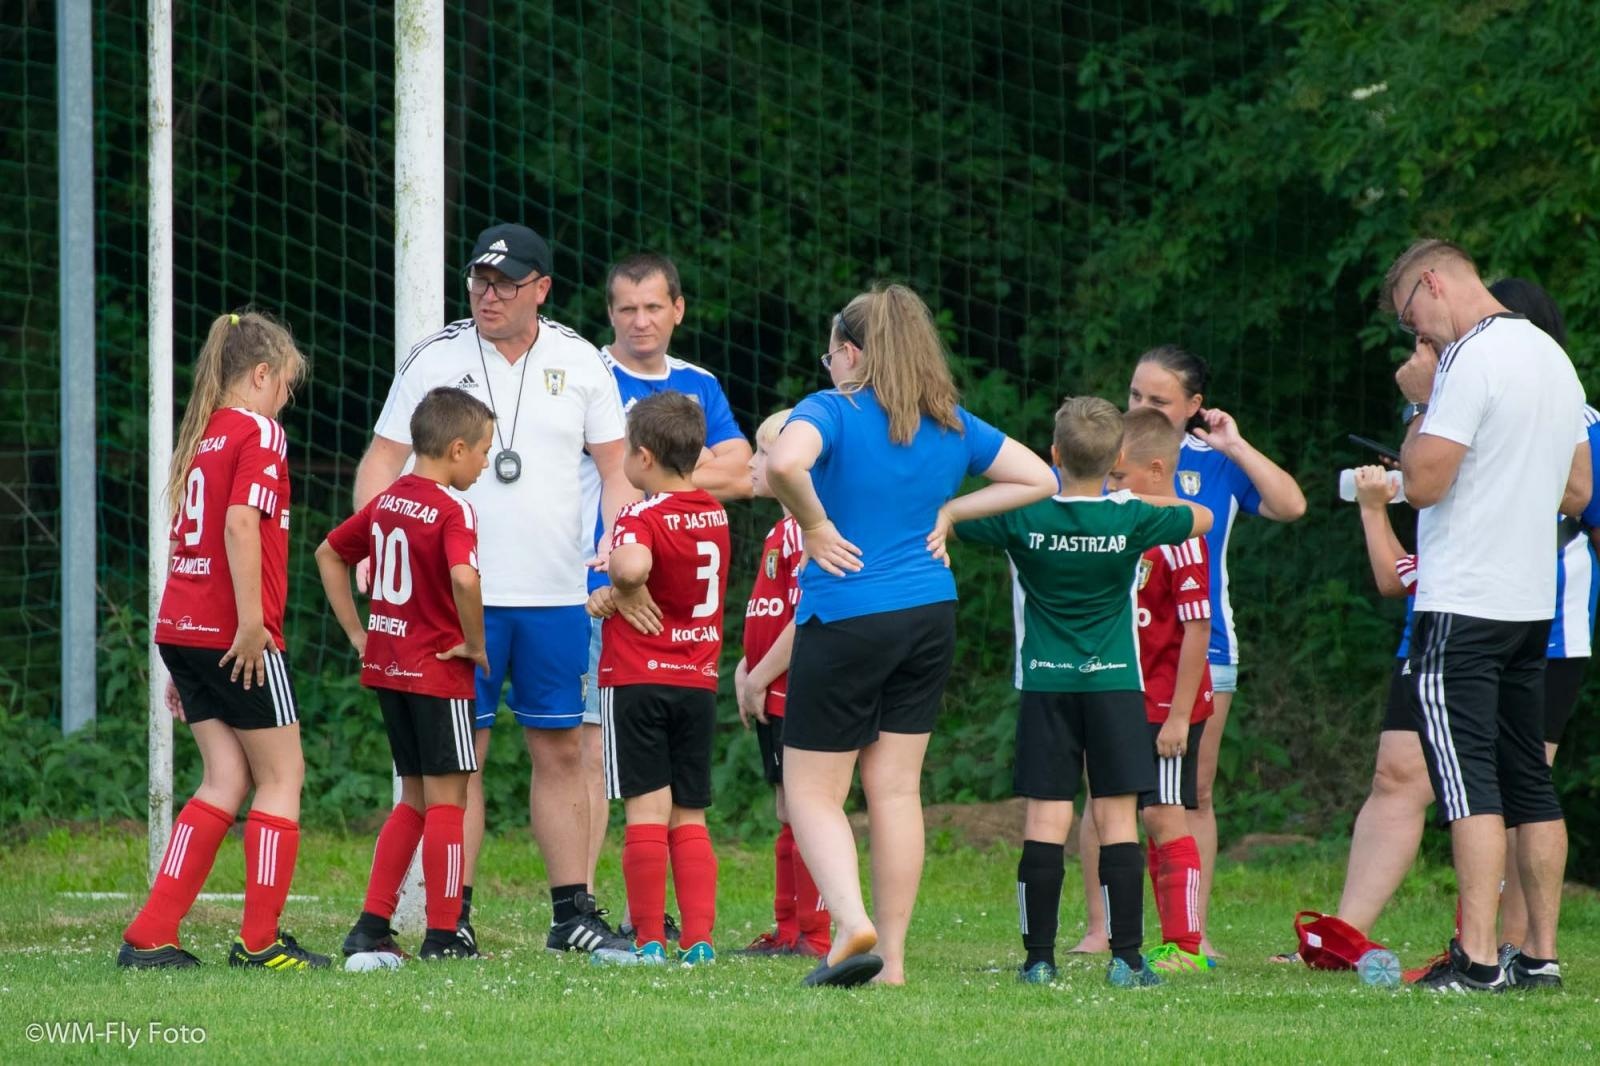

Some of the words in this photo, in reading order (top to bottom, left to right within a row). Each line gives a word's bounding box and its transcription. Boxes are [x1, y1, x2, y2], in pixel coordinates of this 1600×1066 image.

[663, 514, 681, 530] TP
[1028, 532, 1045, 550] TP
[372, 521, 412, 605] 10
[691, 541, 721, 618] 3
